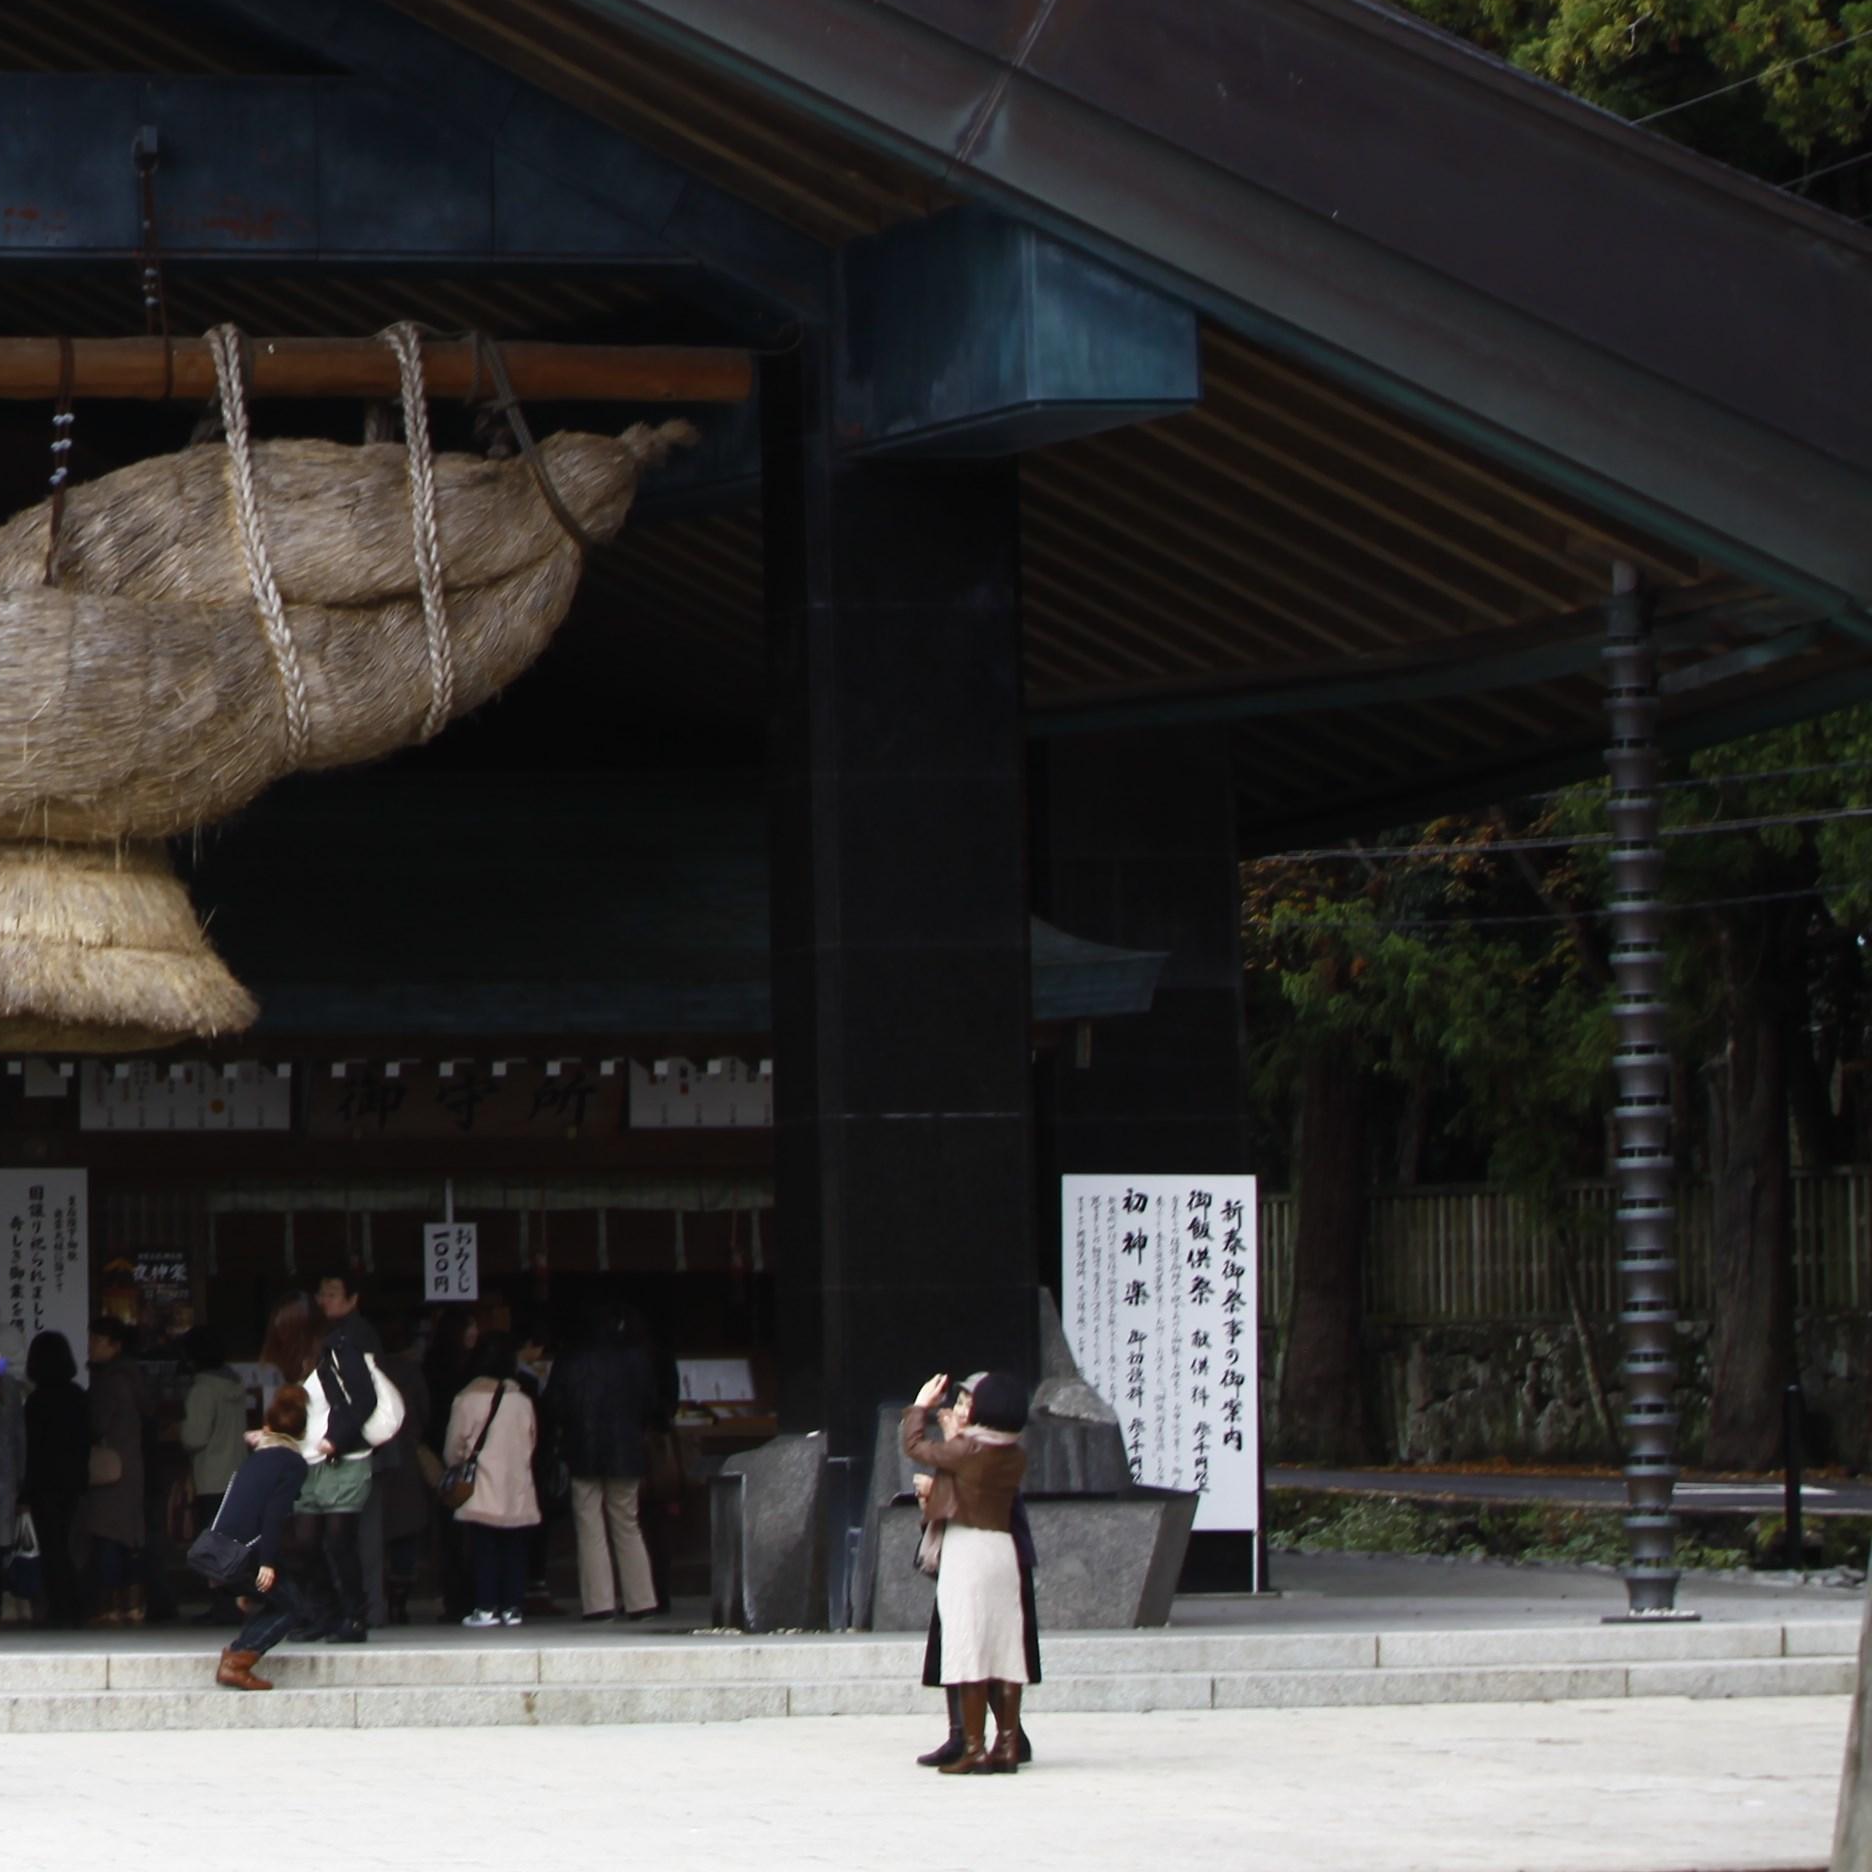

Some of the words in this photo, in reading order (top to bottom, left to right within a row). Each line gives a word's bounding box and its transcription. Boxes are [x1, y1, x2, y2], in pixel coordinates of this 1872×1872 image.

[454, 1227, 472, 1294] おみくじ
[1121, 1187, 1150, 1307] 初神楽
[1186, 1188, 1215, 1306] 御飯供祭
[1190, 1328, 1212, 1408] 献供料
[1219, 1199, 1247, 1452] 新春御祭事の御案内
